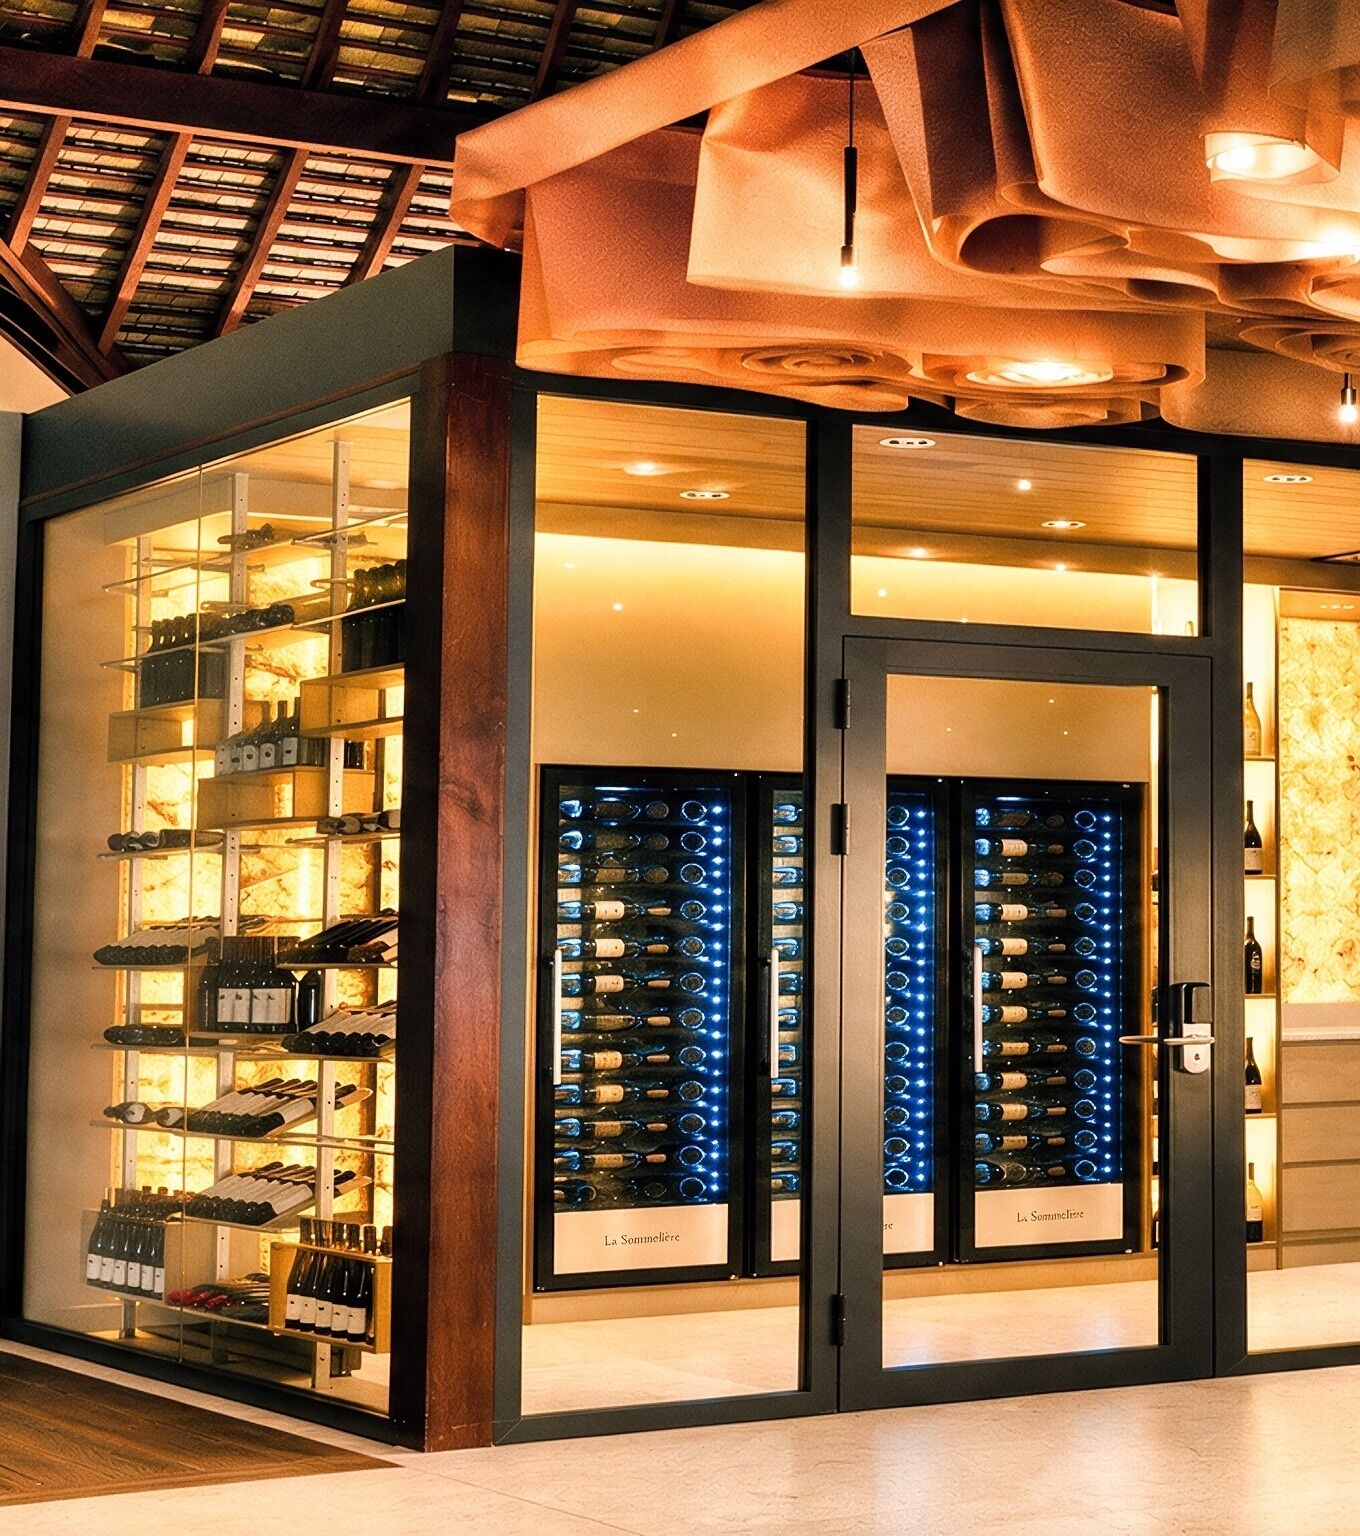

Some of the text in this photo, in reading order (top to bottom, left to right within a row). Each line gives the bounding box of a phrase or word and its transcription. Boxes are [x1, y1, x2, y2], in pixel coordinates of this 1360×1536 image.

[1016, 1212, 1028, 1223] La
[604, 1231, 680, 1246] La Sommelière
